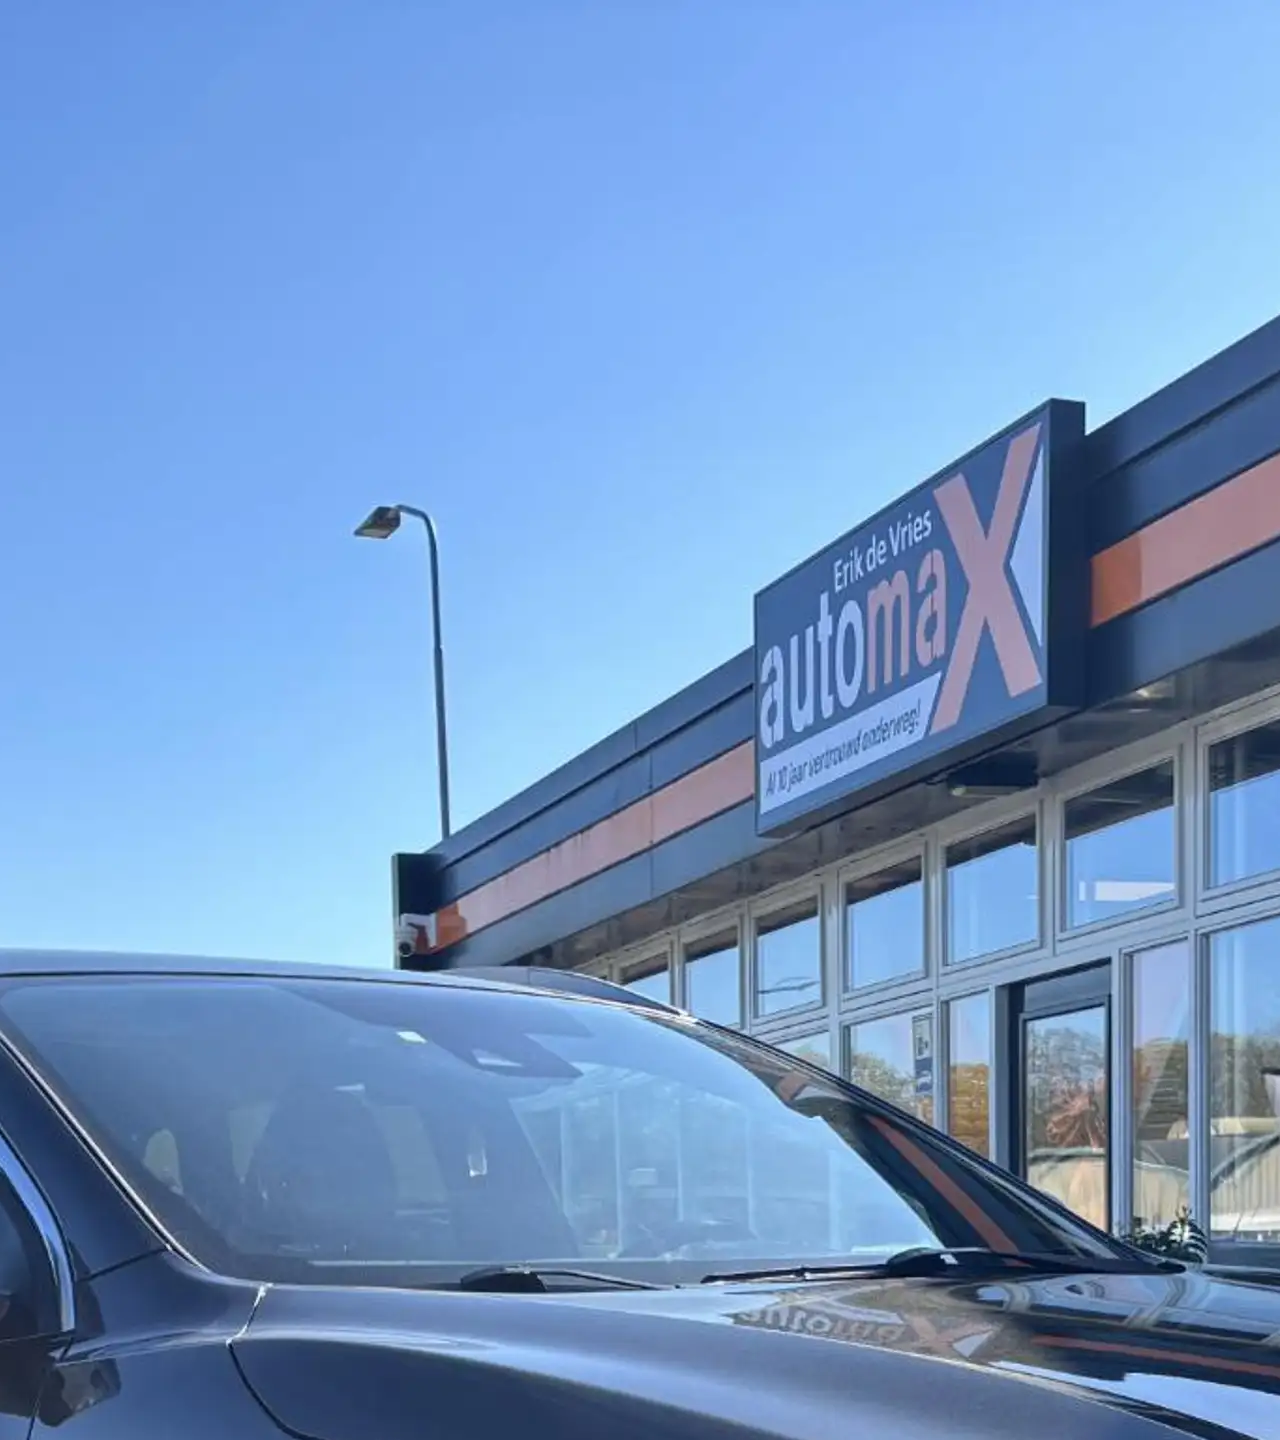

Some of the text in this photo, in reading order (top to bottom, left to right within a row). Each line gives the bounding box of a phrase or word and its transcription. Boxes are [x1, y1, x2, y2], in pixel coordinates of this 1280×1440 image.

[833, 510, 933, 592] Erik de Vries
